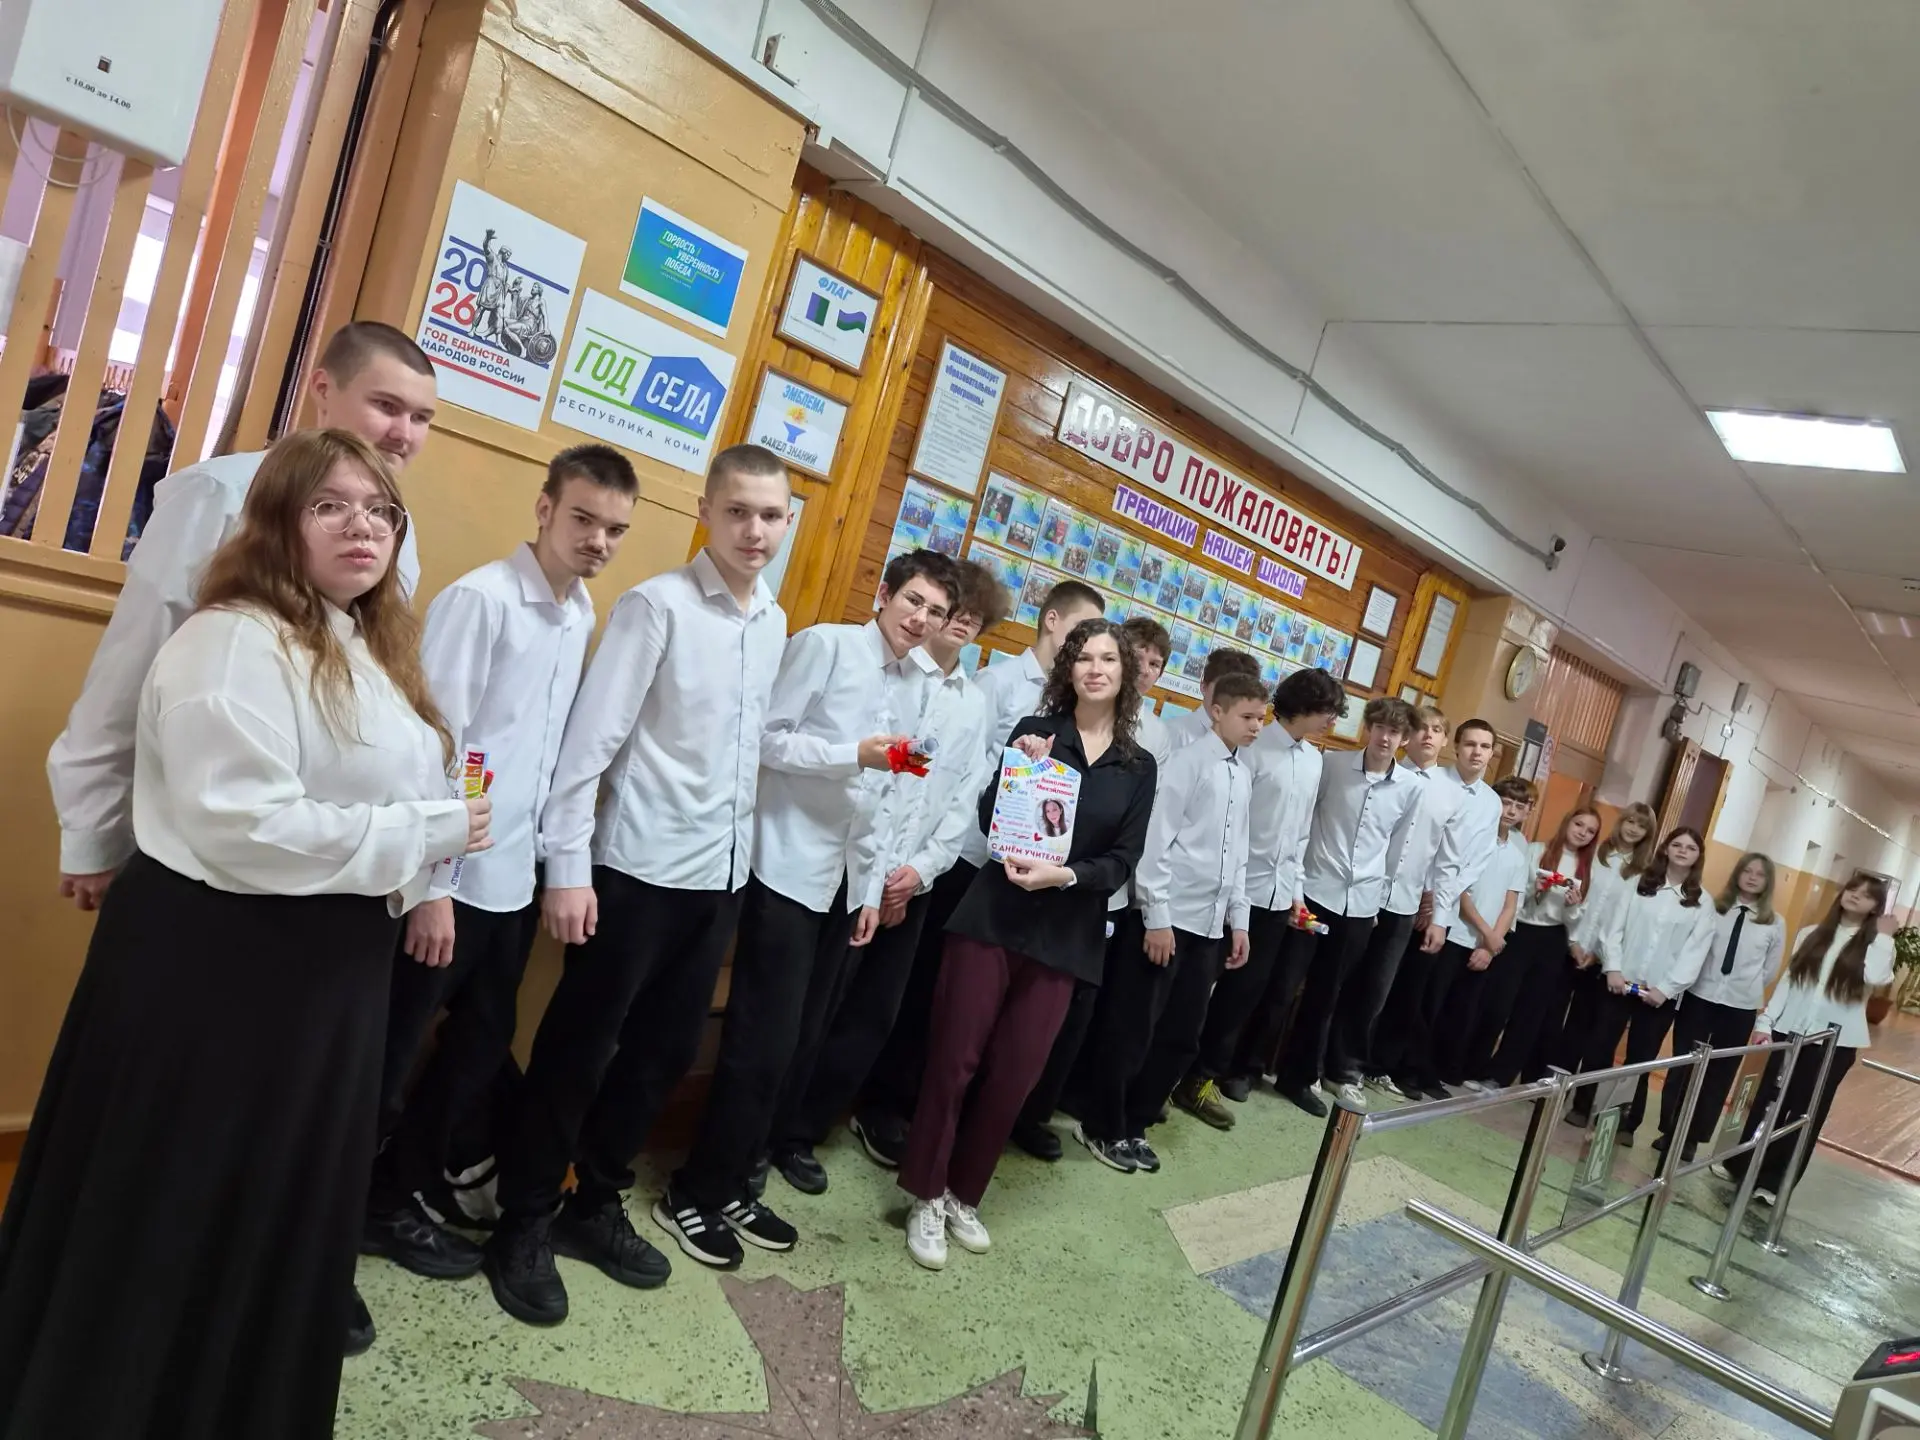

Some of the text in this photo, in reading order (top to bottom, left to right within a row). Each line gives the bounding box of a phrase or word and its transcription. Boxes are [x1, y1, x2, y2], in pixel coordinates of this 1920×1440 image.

[662, 230, 696, 255] ГОРДОСТЬ
[440, 247, 487, 293] 20
[664, 256, 692, 277] ПОБЕДА
[676, 250, 721, 279] УВЕРЕННОСТЬ
[431, 281, 477, 326] 26
[817, 276, 854, 301] ФЛАГ
[421, 338, 525, 385] НАРОДОВ РОССИИ
[424, 326, 510, 367] ГОД ЕДИНСТВА
[574, 340, 712, 425] ГОД СЕЛА
[782, 384, 826, 415] ЭМБЛЕМА
[558, 395, 700, 457] РЕСПУБЛИКА КОМИ
[760, 434, 819, 466] ФАКЕЛ ЗНАНИЙ
[1063, 391, 1175, 484] ДОБРО
[1180, 456, 1355, 581] ПОЖАЛОВАТЬ!
[1116, 487, 1199, 546] ТРАДИЦИИ
[1203, 530, 1255, 574] НАШЕЙ
[1257, 558, 1307, 599] ШКОЛЫ
[999, 844, 1022, 855] ДНЁМ
[1025, 849, 1064, 862] УЧИТЕЛЯ!
